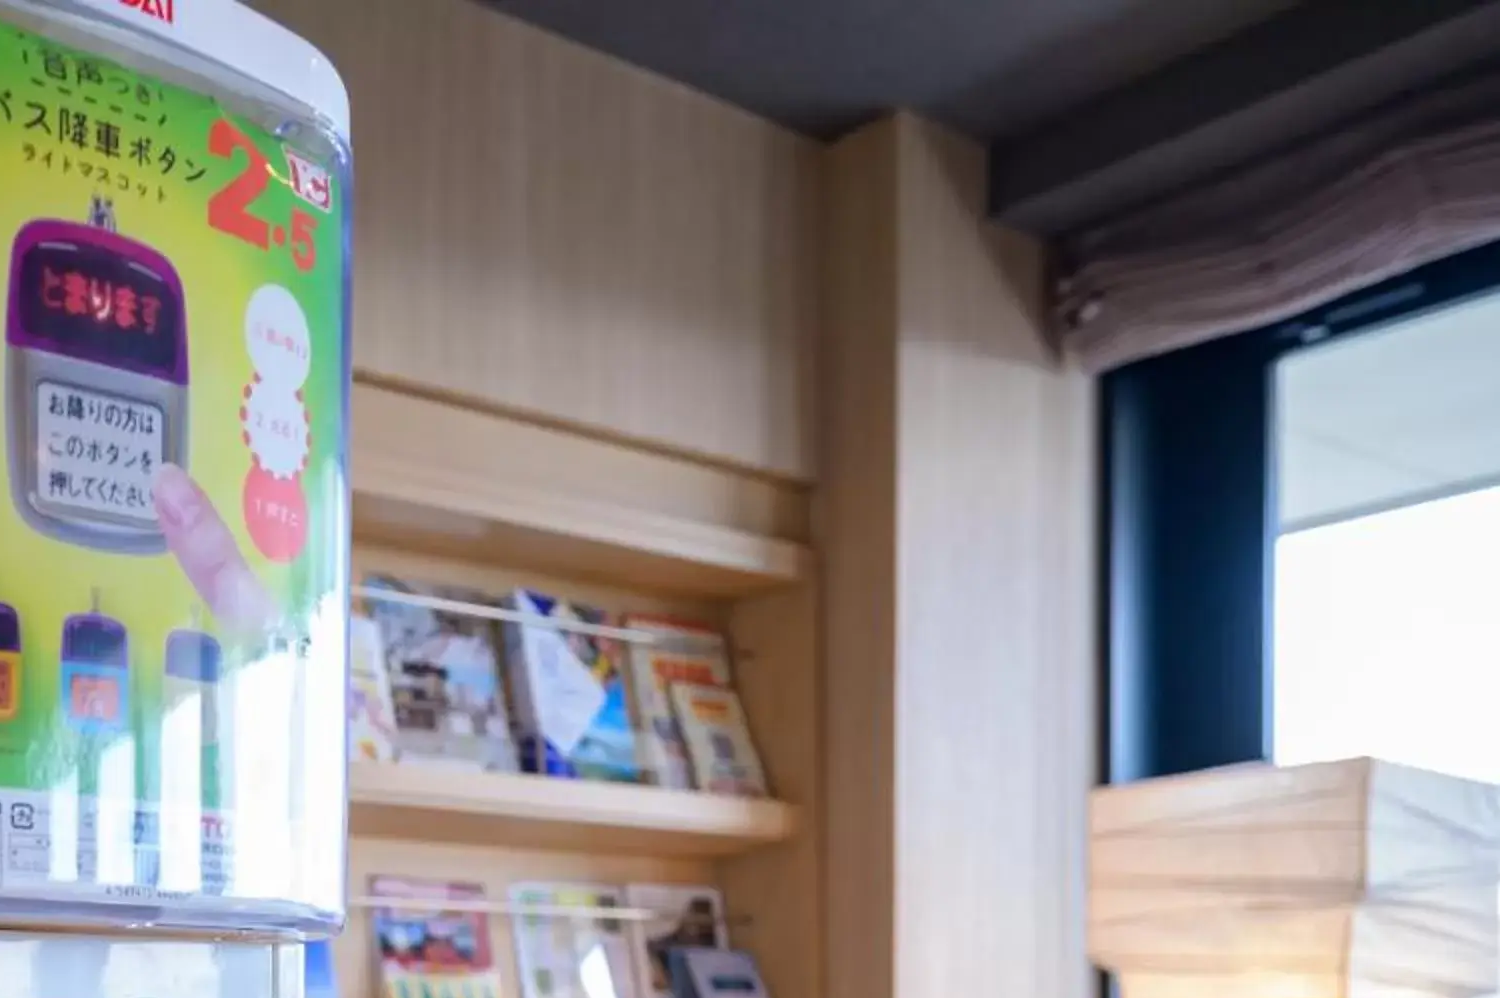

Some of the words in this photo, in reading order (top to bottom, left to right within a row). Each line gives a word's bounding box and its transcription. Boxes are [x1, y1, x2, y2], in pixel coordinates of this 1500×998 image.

[208, 118, 318, 272] 2.5
[41, 265, 162, 335] とまります
[48, 392, 155, 435] お降りの方は
[47, 431, 153, 476] このボタンを
